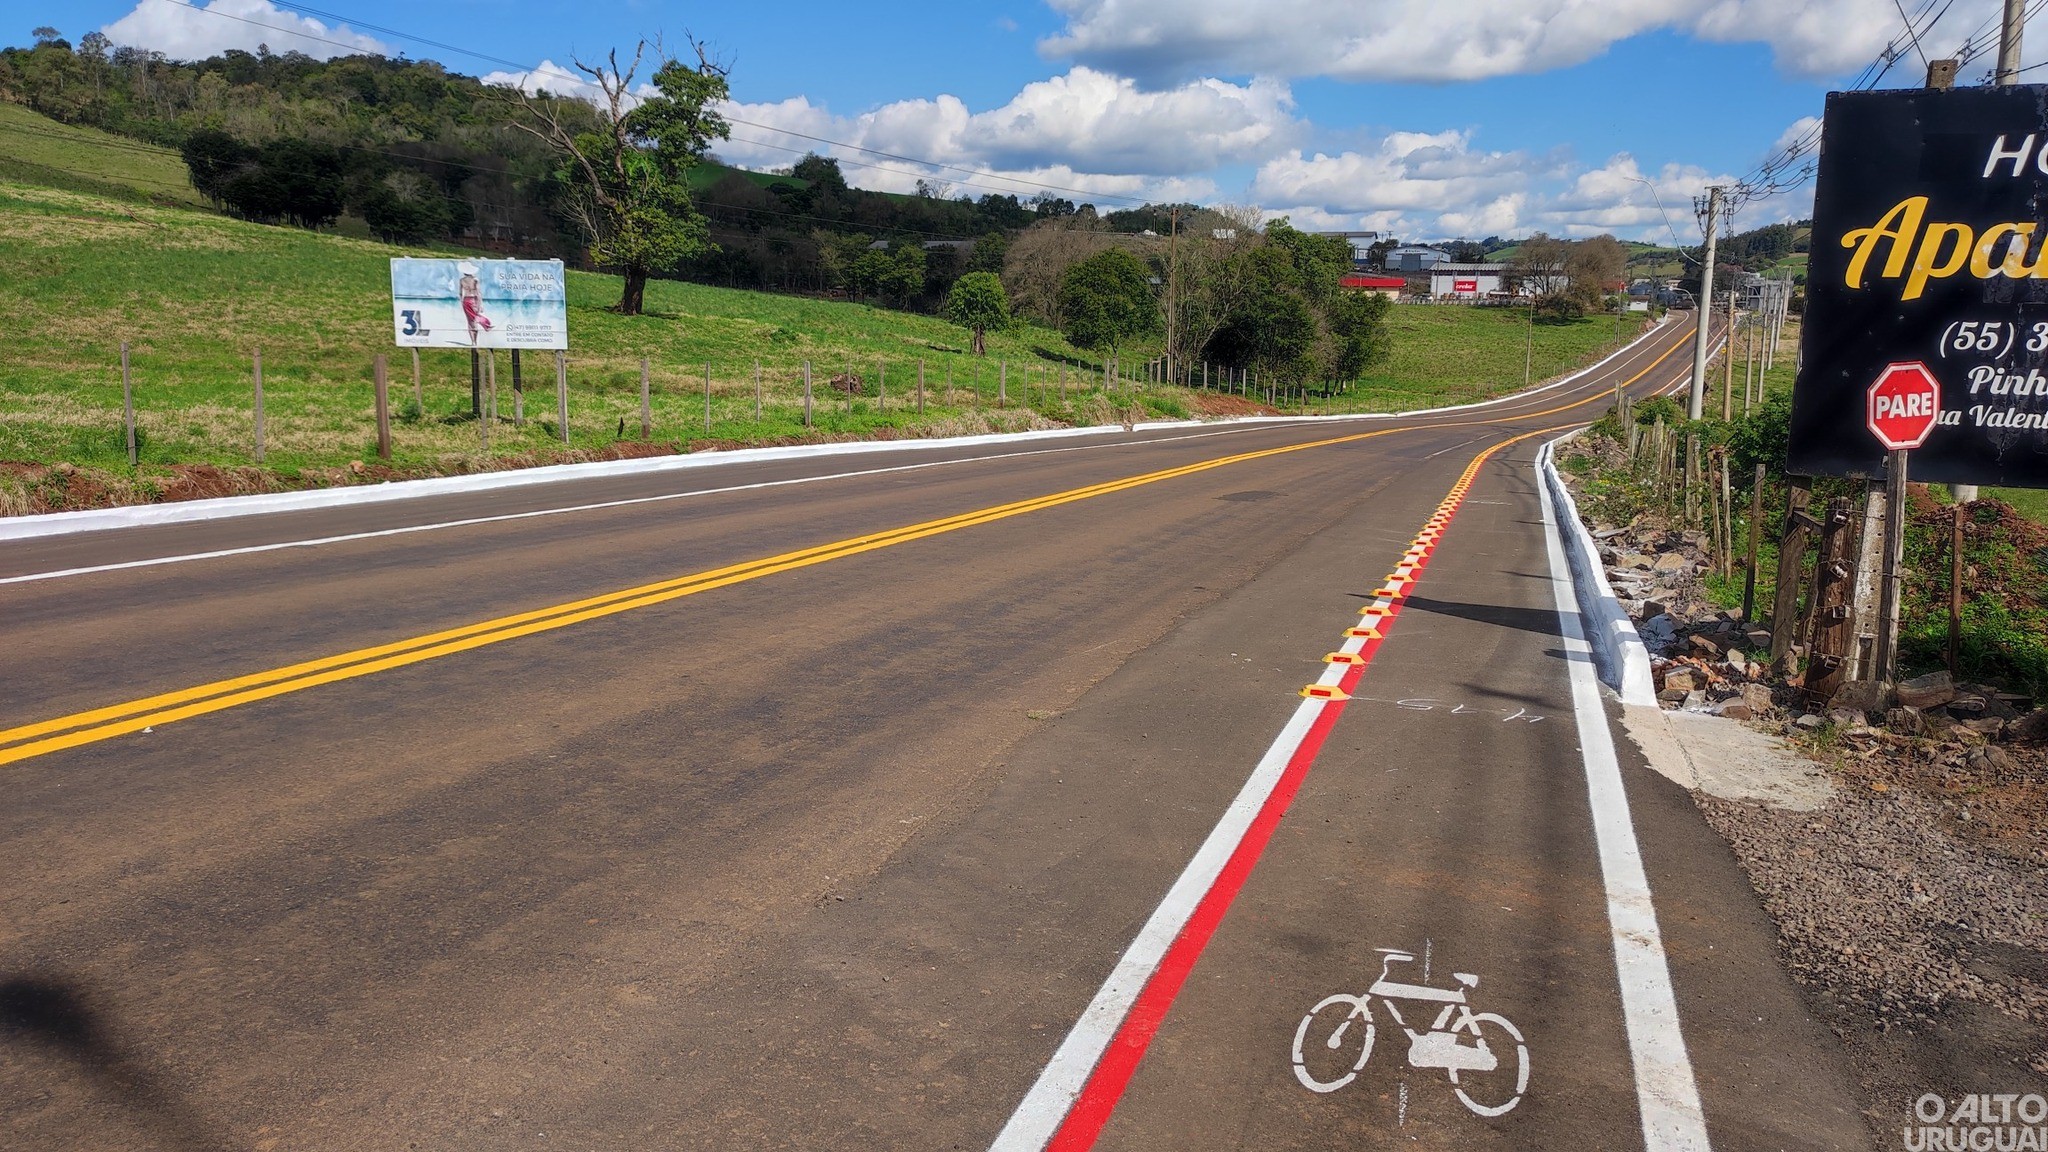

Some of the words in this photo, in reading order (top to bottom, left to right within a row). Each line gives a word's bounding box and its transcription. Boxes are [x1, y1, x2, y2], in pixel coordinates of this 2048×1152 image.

[1982, 134, 2048, 177] H
[501, 283, 528, 291] PRAIA
[542, 273, 555, 281] NA
[1939, 321, 2015, 359] (55)
[1876, 392, 1933, 419] PARE
